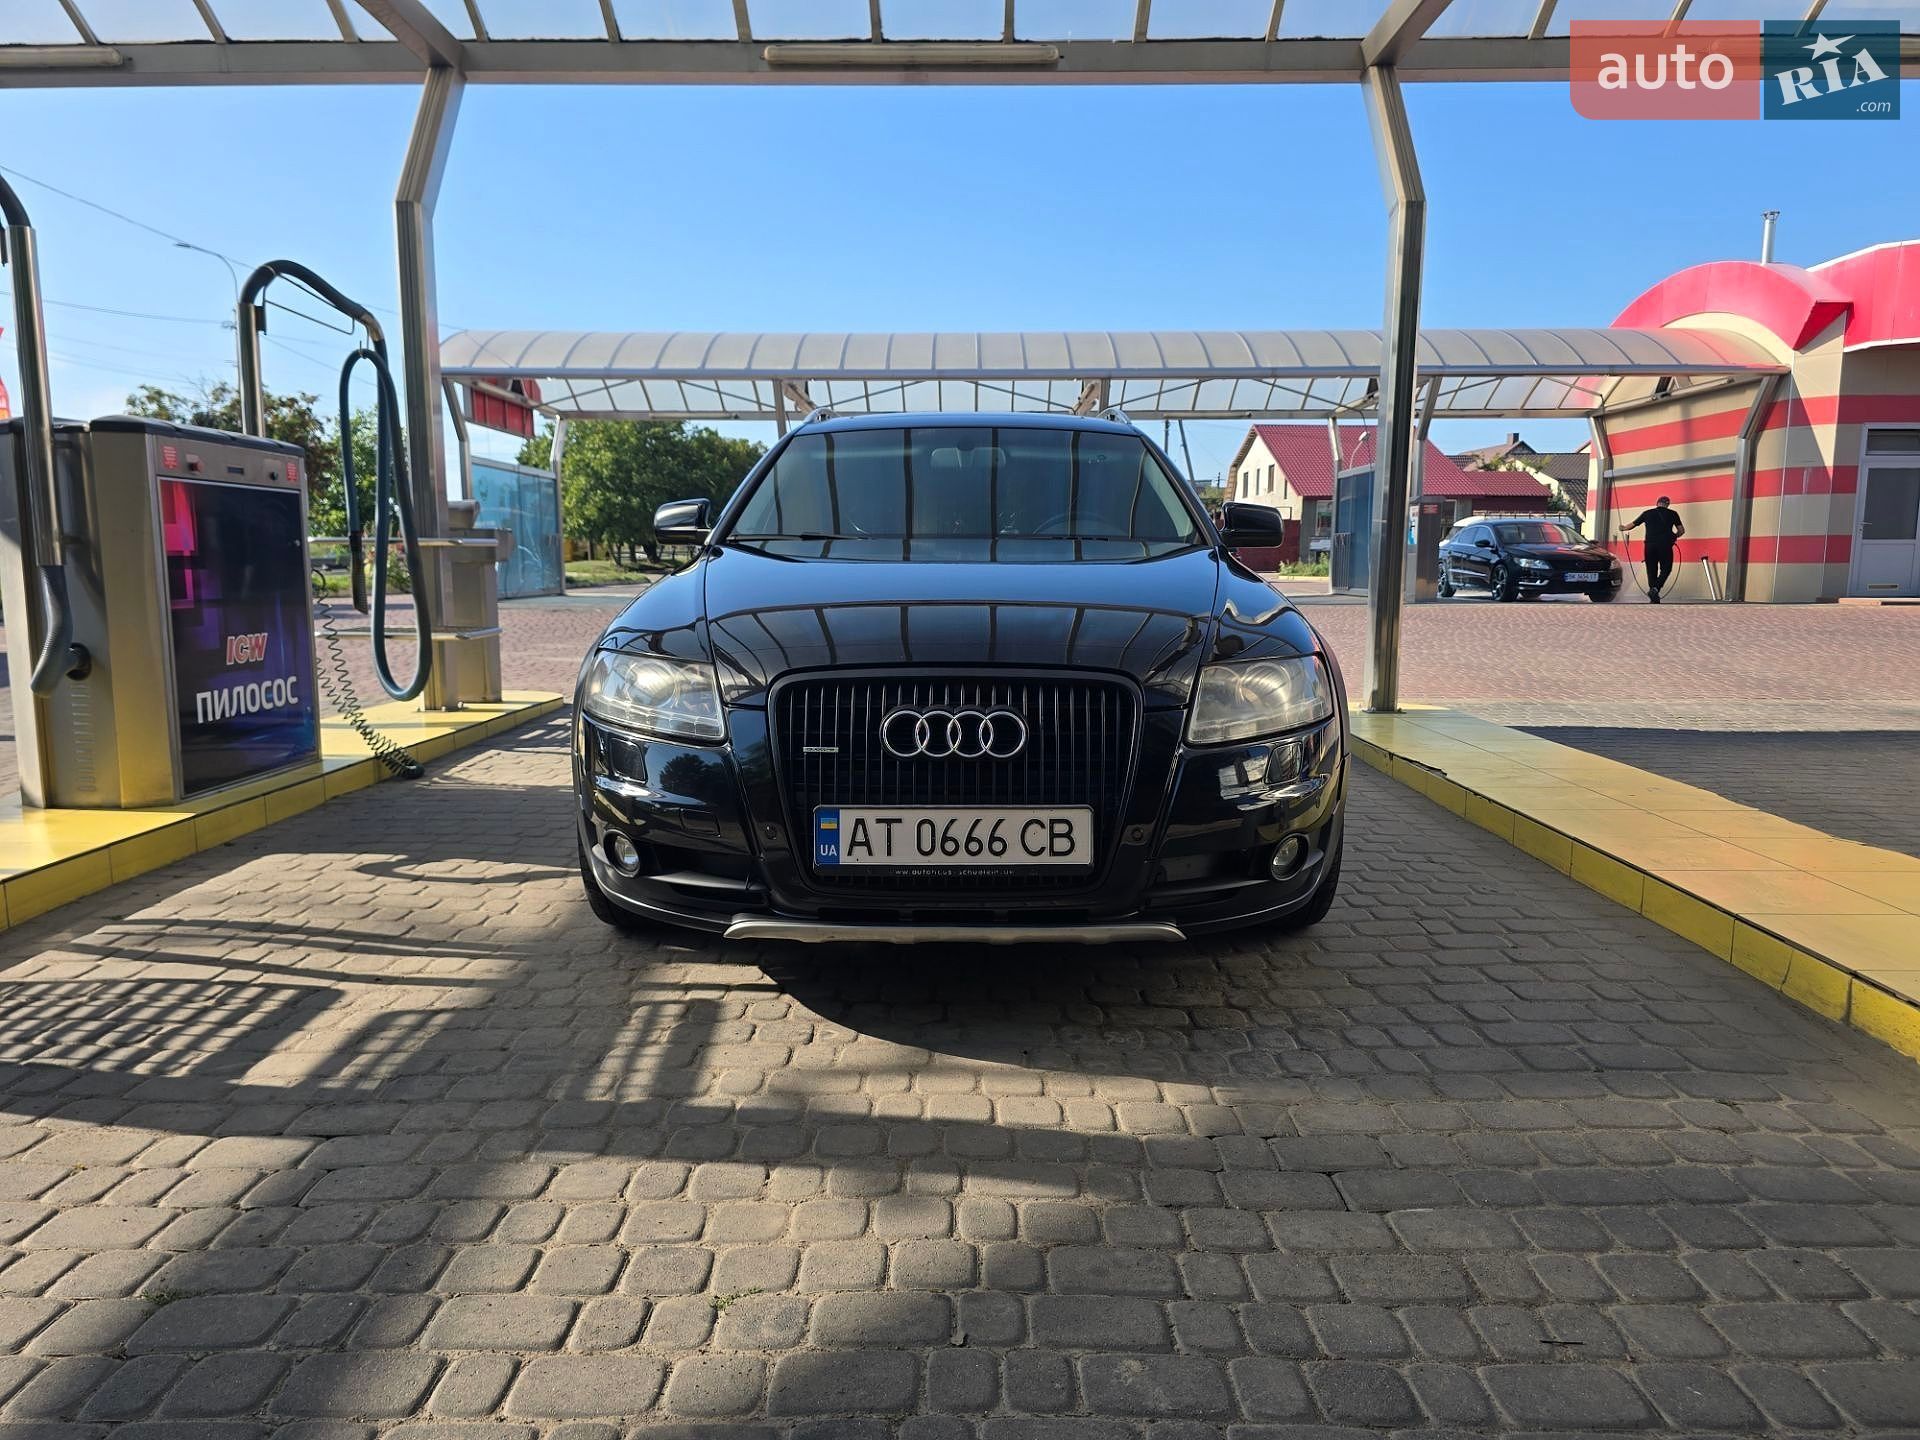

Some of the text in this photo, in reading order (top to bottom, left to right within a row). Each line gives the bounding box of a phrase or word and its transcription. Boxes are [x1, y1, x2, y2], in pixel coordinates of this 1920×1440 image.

[196, 676, 298, 724] ПИЛОСОС
[820, 844, 838, 856] UA
[847, 818, 1076, 857] AT 0666 CB
